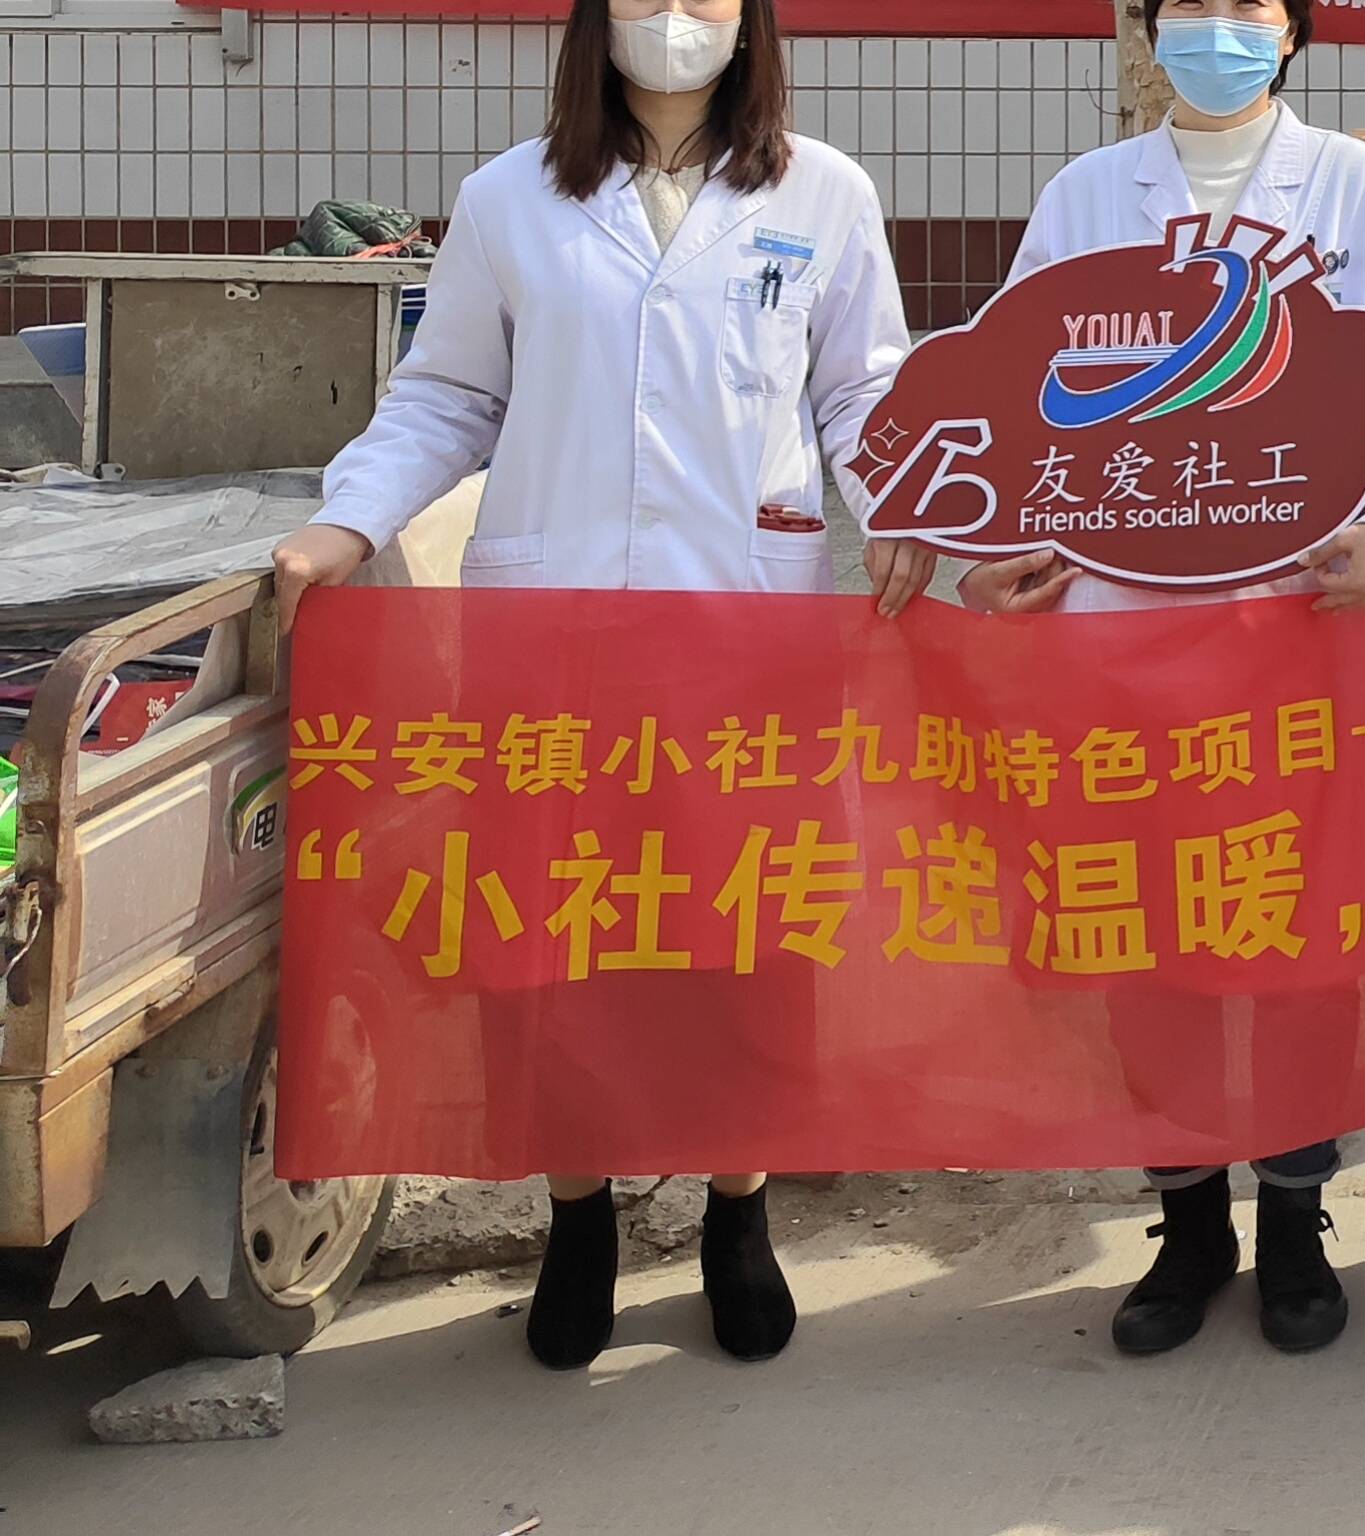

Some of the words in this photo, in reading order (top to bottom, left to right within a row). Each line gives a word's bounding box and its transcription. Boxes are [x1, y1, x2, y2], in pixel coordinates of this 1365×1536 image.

[1061, 310, 1174, 351] YOUAI
[1022, 440, 1309, 505] 友爱社工
[1018, 495, 1118, 534] Friends
[1124, 497, 1201, 528] social
[1208, 495, 1305, 525] worker
